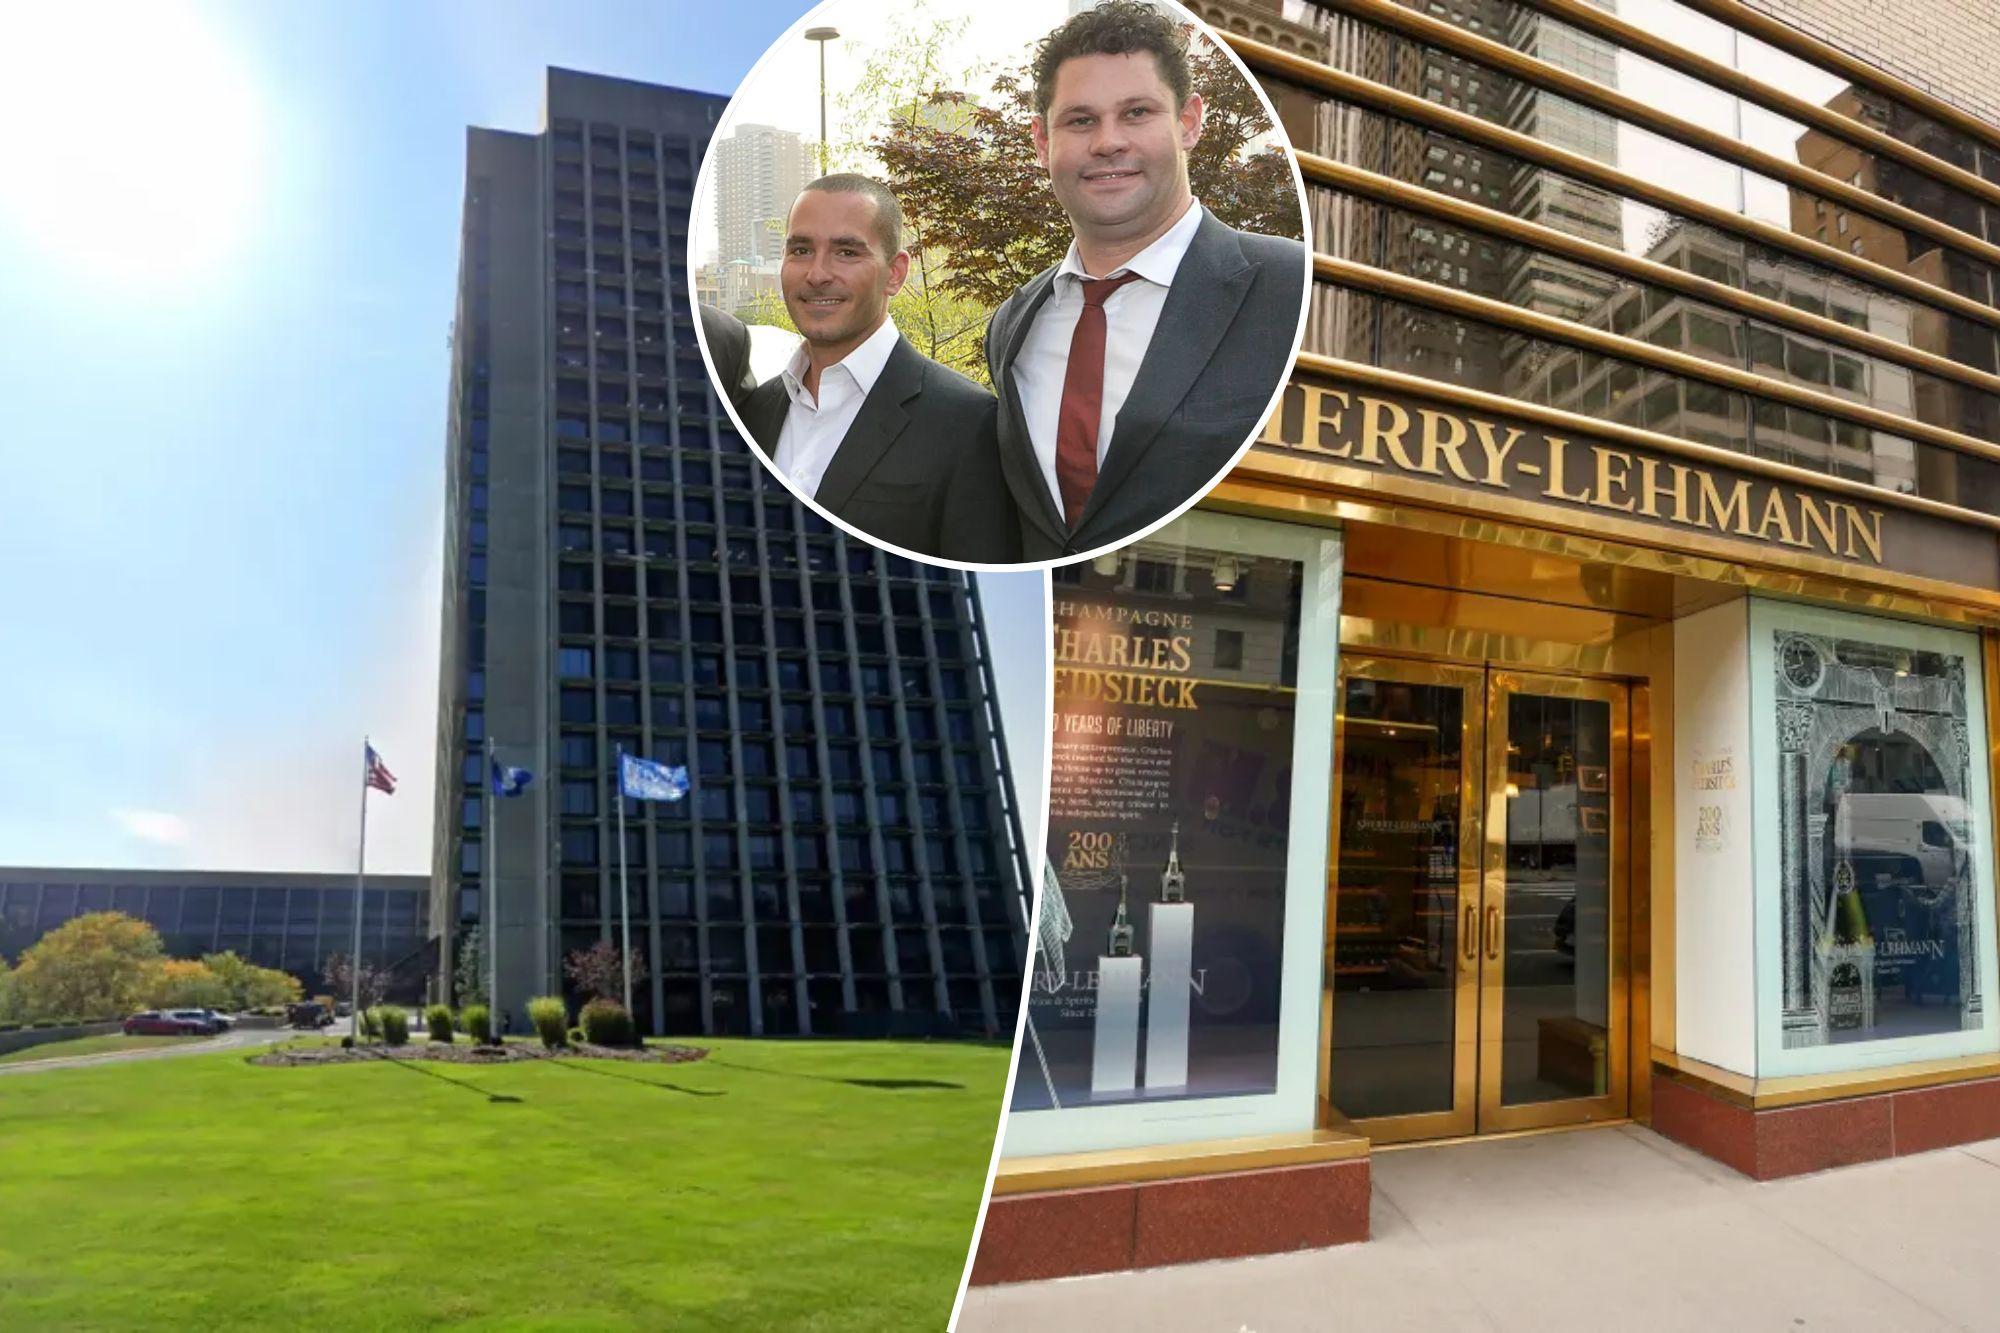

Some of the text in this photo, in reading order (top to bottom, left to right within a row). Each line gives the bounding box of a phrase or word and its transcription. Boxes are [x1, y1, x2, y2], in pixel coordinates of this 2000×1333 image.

[1053, 601, 1193, 630] HAMPAGNE
[1064, 713, 1103, 734] YEARS
[1107, 716, 1122, 736] OF
[1126, 718, 1174, 740] LIBERTY
[1068, 831, 1112, 851] 200
[1063, 850, 1109, 869] ANS
